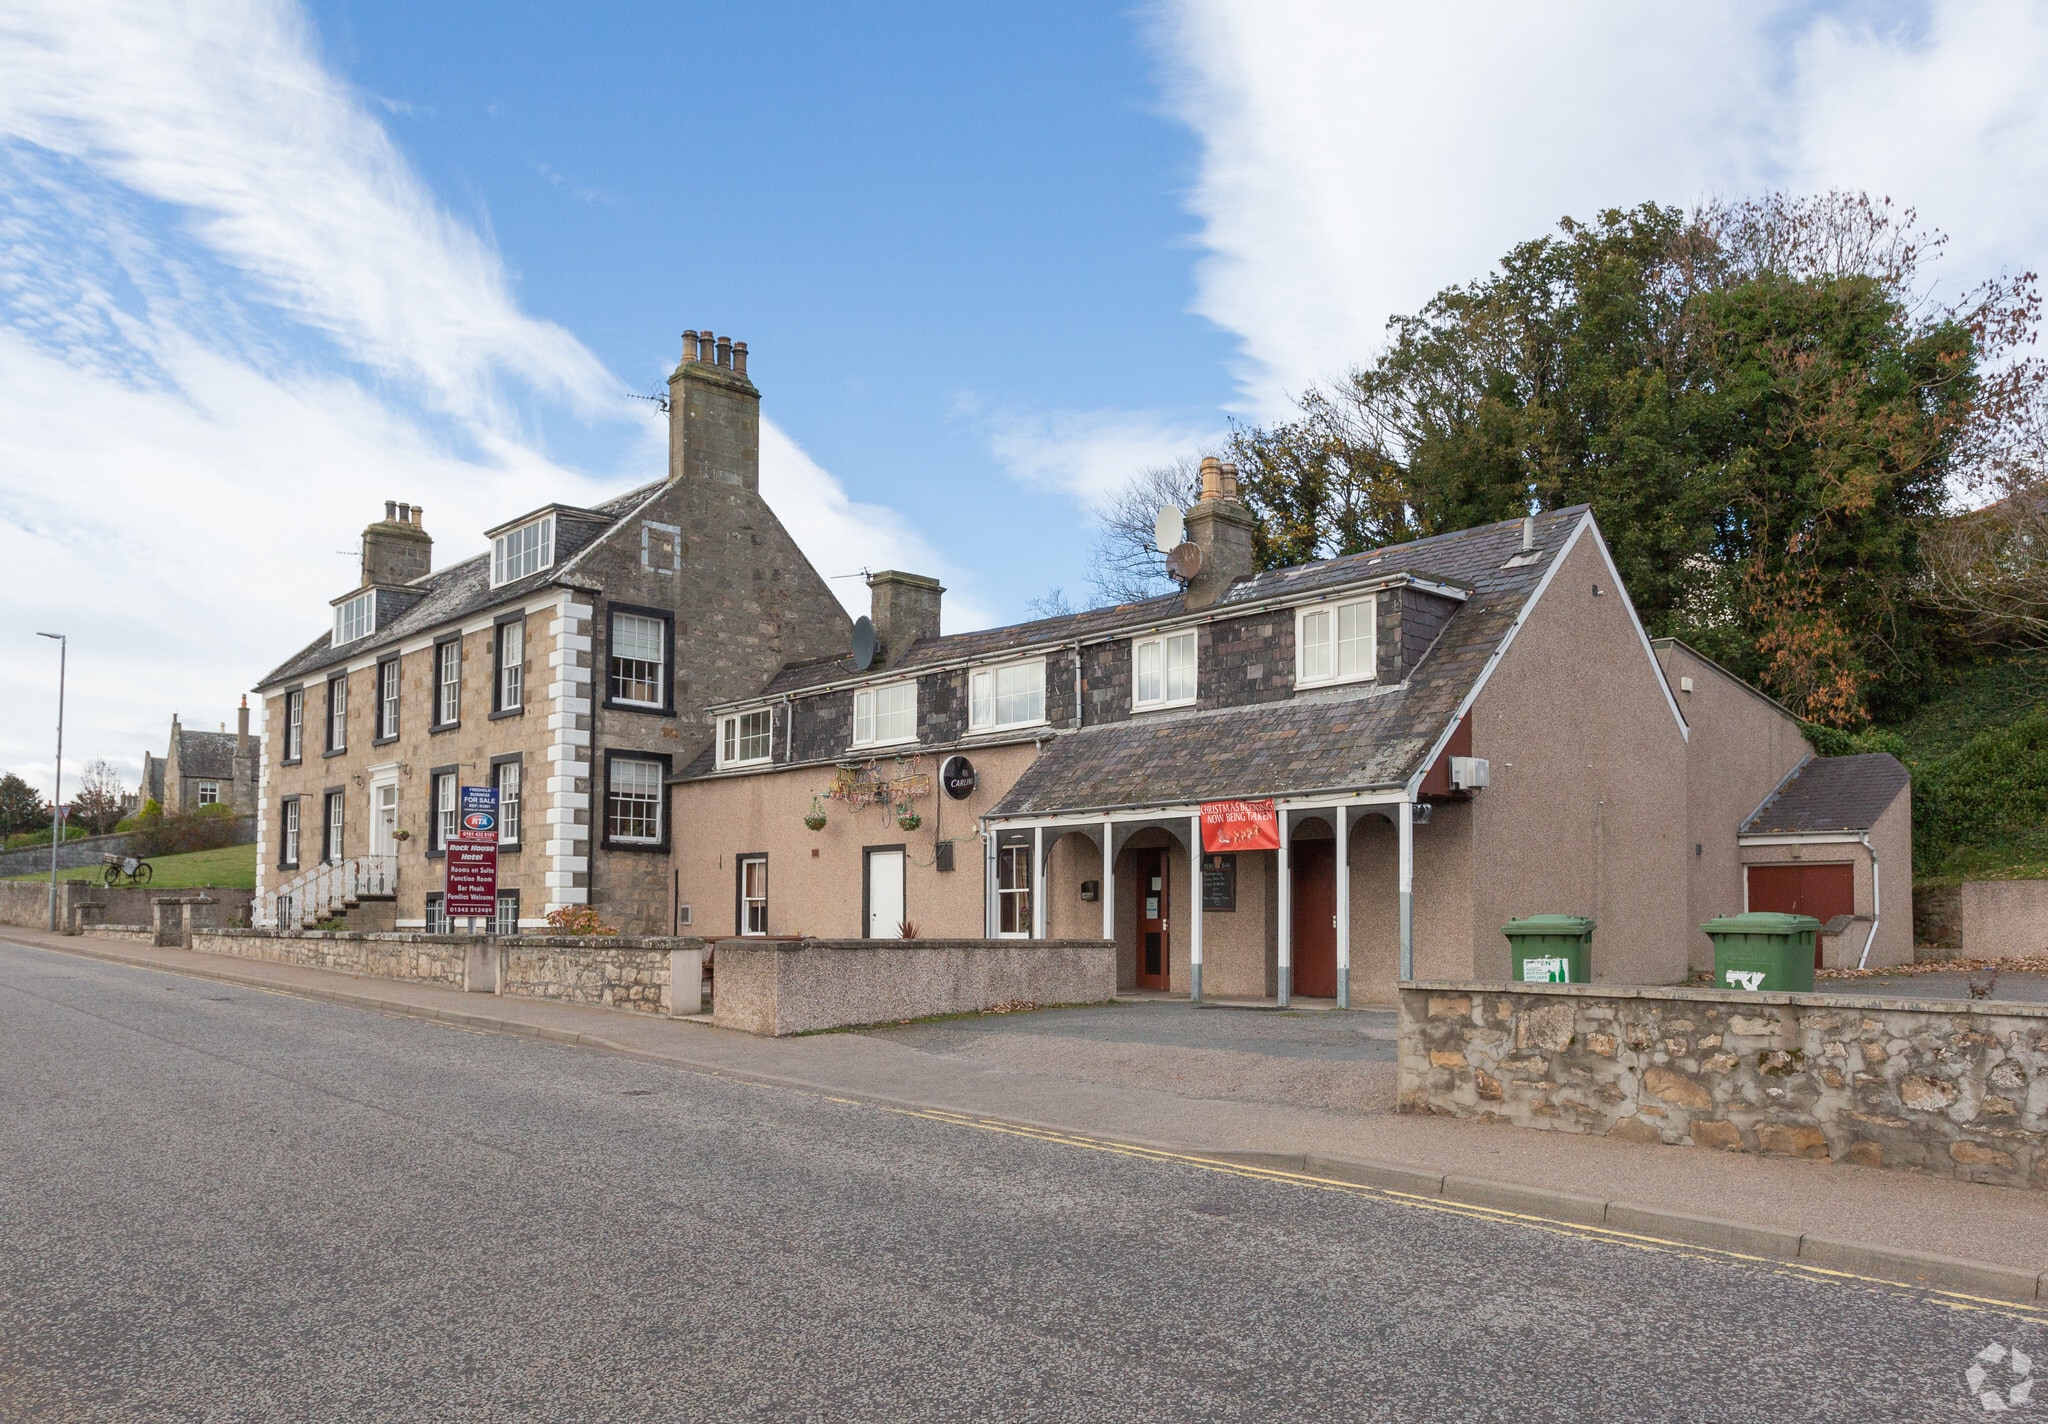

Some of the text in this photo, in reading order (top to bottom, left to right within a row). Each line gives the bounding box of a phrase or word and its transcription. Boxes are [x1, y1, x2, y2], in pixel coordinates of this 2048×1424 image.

[1200, 802, 1239, 814] CHRISTMAS
[1207, 811, 1273, 824] NOW BEING TAKEN
